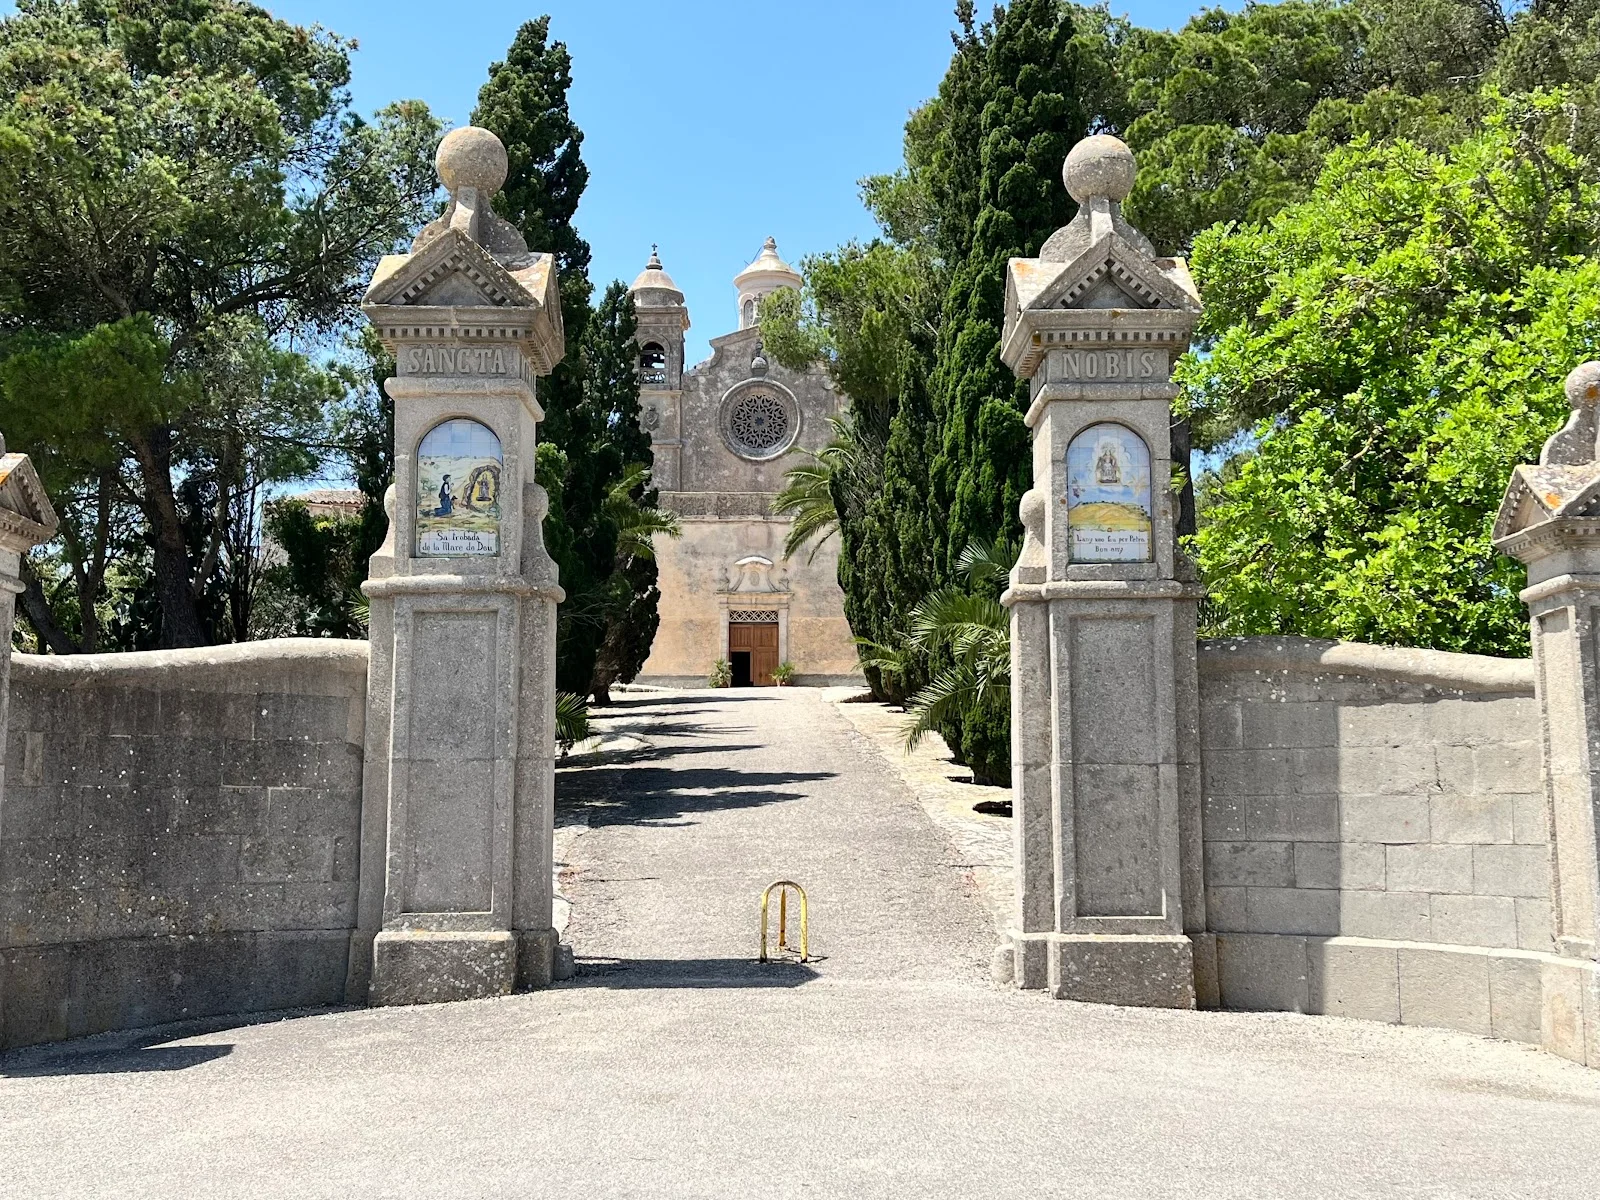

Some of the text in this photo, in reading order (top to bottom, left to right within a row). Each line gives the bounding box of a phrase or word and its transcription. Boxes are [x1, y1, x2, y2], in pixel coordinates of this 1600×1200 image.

[407, 348, 506, 374] SANCTA
[1062, 352, 1155, 379] NOBIS
[422, 542, 431, 551] de
[433, 542, 440, 551] la
[442, 541, 464, 551] Mare
[466, 542, 475, 551] de
[1095, 545, 1108, 553] Bon
